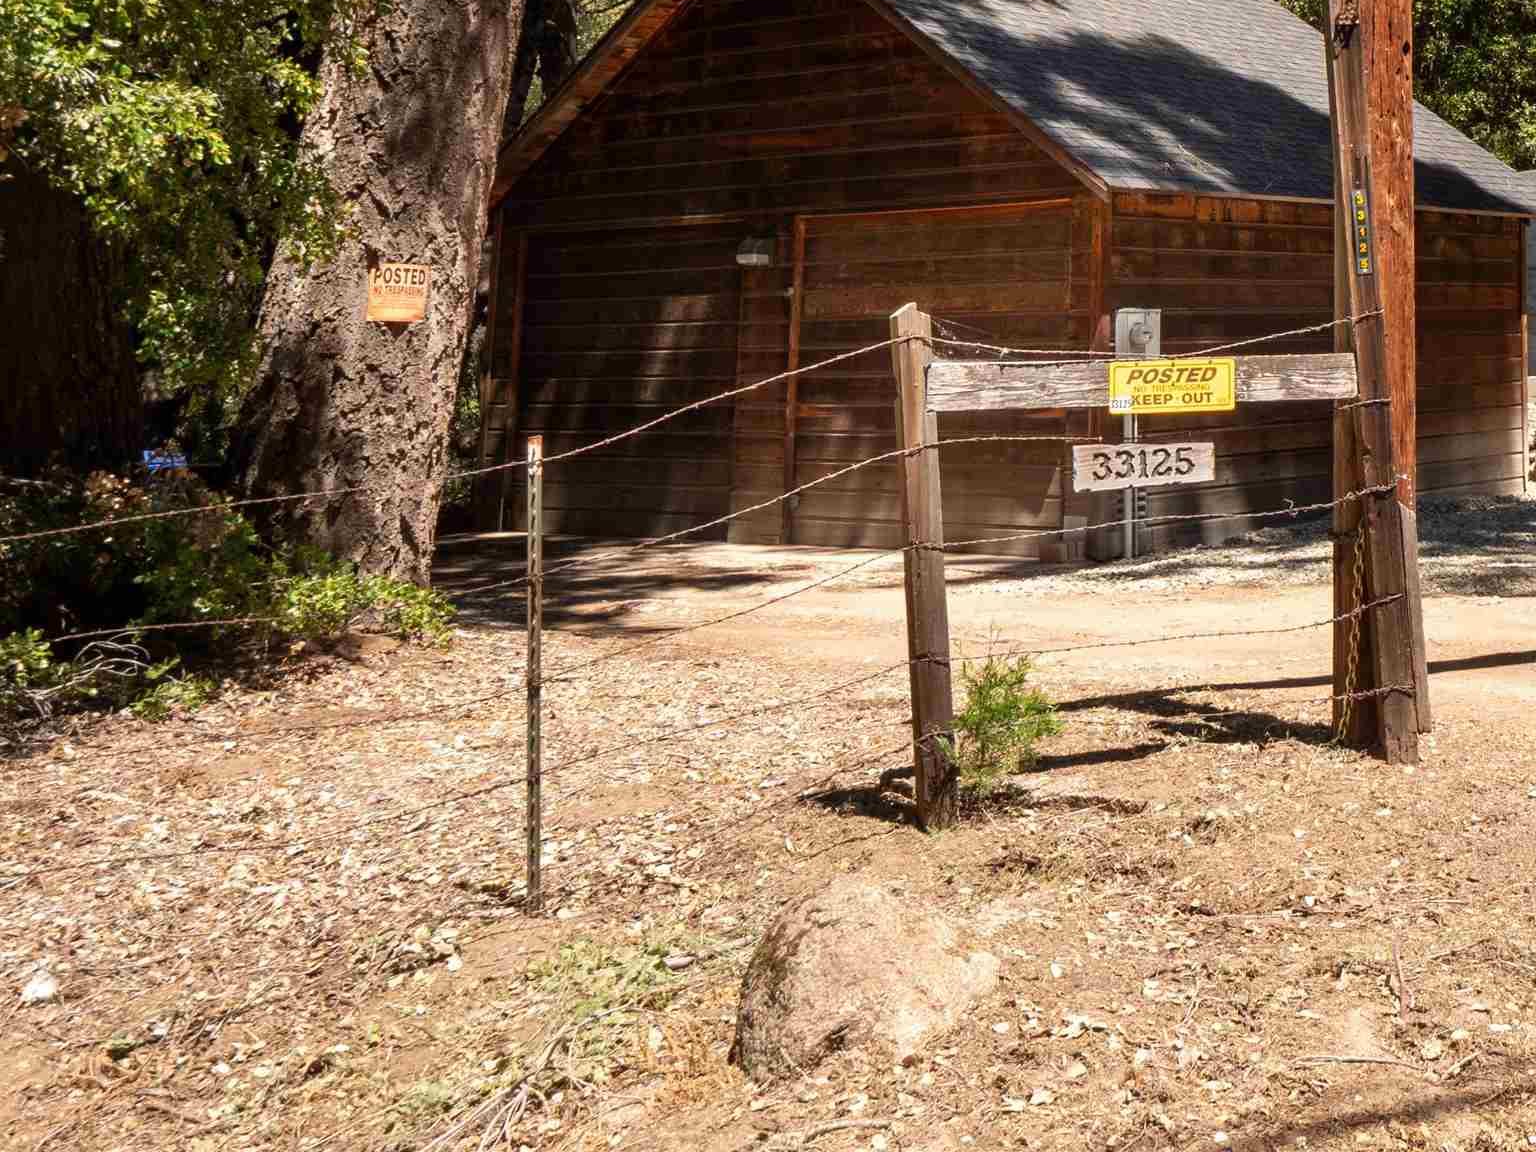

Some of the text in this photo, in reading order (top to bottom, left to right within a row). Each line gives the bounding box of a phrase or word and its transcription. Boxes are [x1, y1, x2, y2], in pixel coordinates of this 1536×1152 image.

[374, 267, 425, 285] POSTED
[1126, 367, 1217, 385] POSTED
[1132, 392, 1213, 406] KEEP OUT
[1092, 447, 1196, 481] 33125
